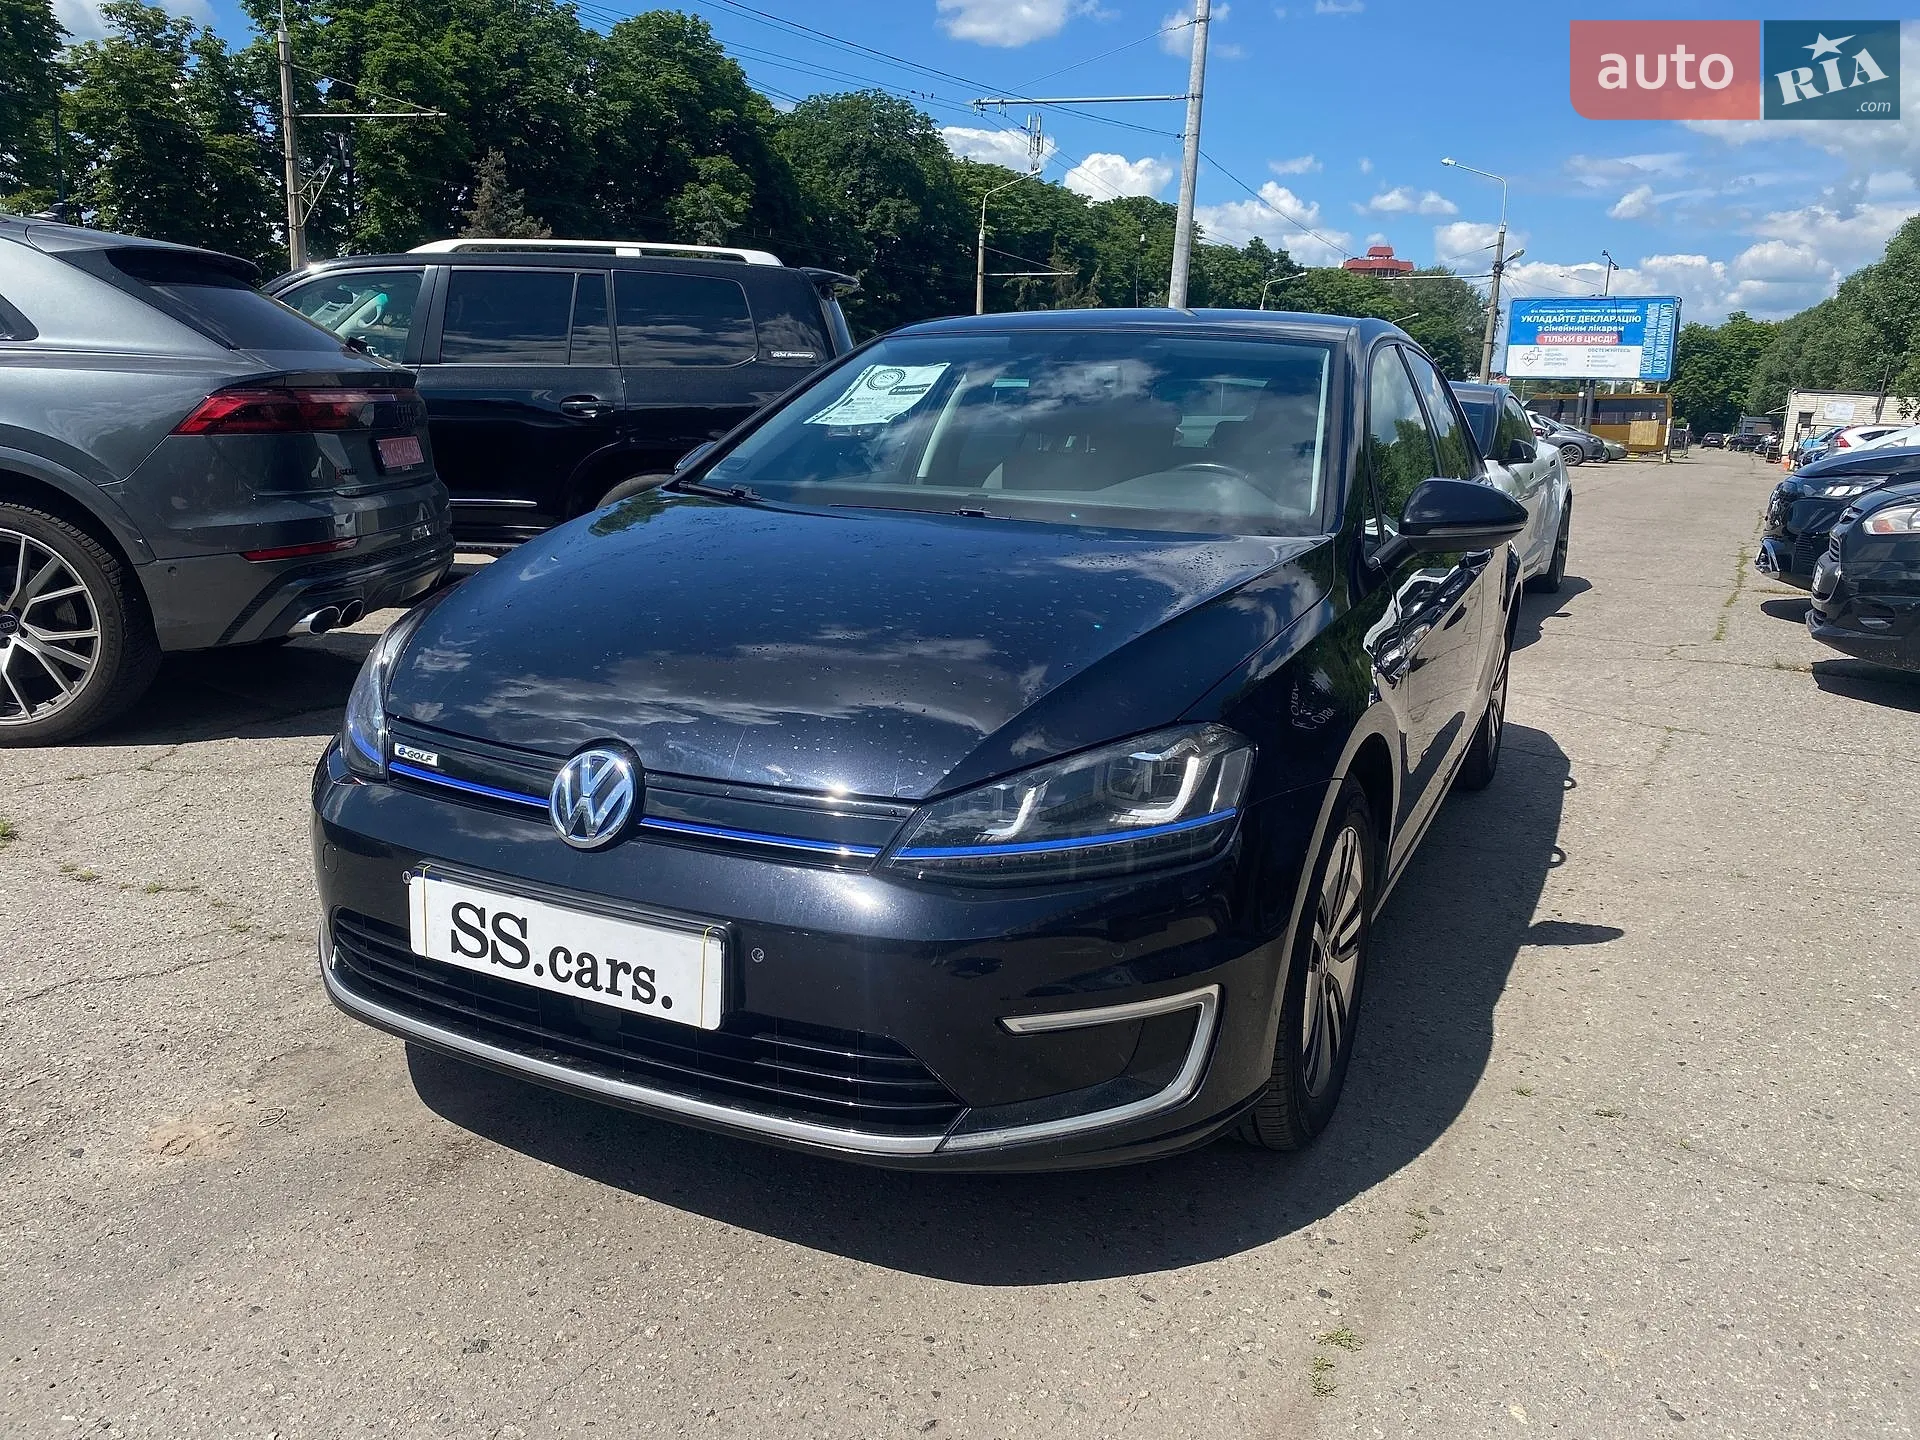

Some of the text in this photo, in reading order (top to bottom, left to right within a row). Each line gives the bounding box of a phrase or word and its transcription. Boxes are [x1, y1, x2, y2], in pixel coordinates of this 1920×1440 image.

[1521, 314, 1642, 323] УКЛАДАЙТЕ ДЕКЛАРАЦІЮ
[1544, 324, 1587, 332] сімейним
[1588, 324, 1625, 333] лікарем
[1543, 335, 1575, 343] ТІЛЬКИ
[451, 902, 674, 1009] SS.cars.
